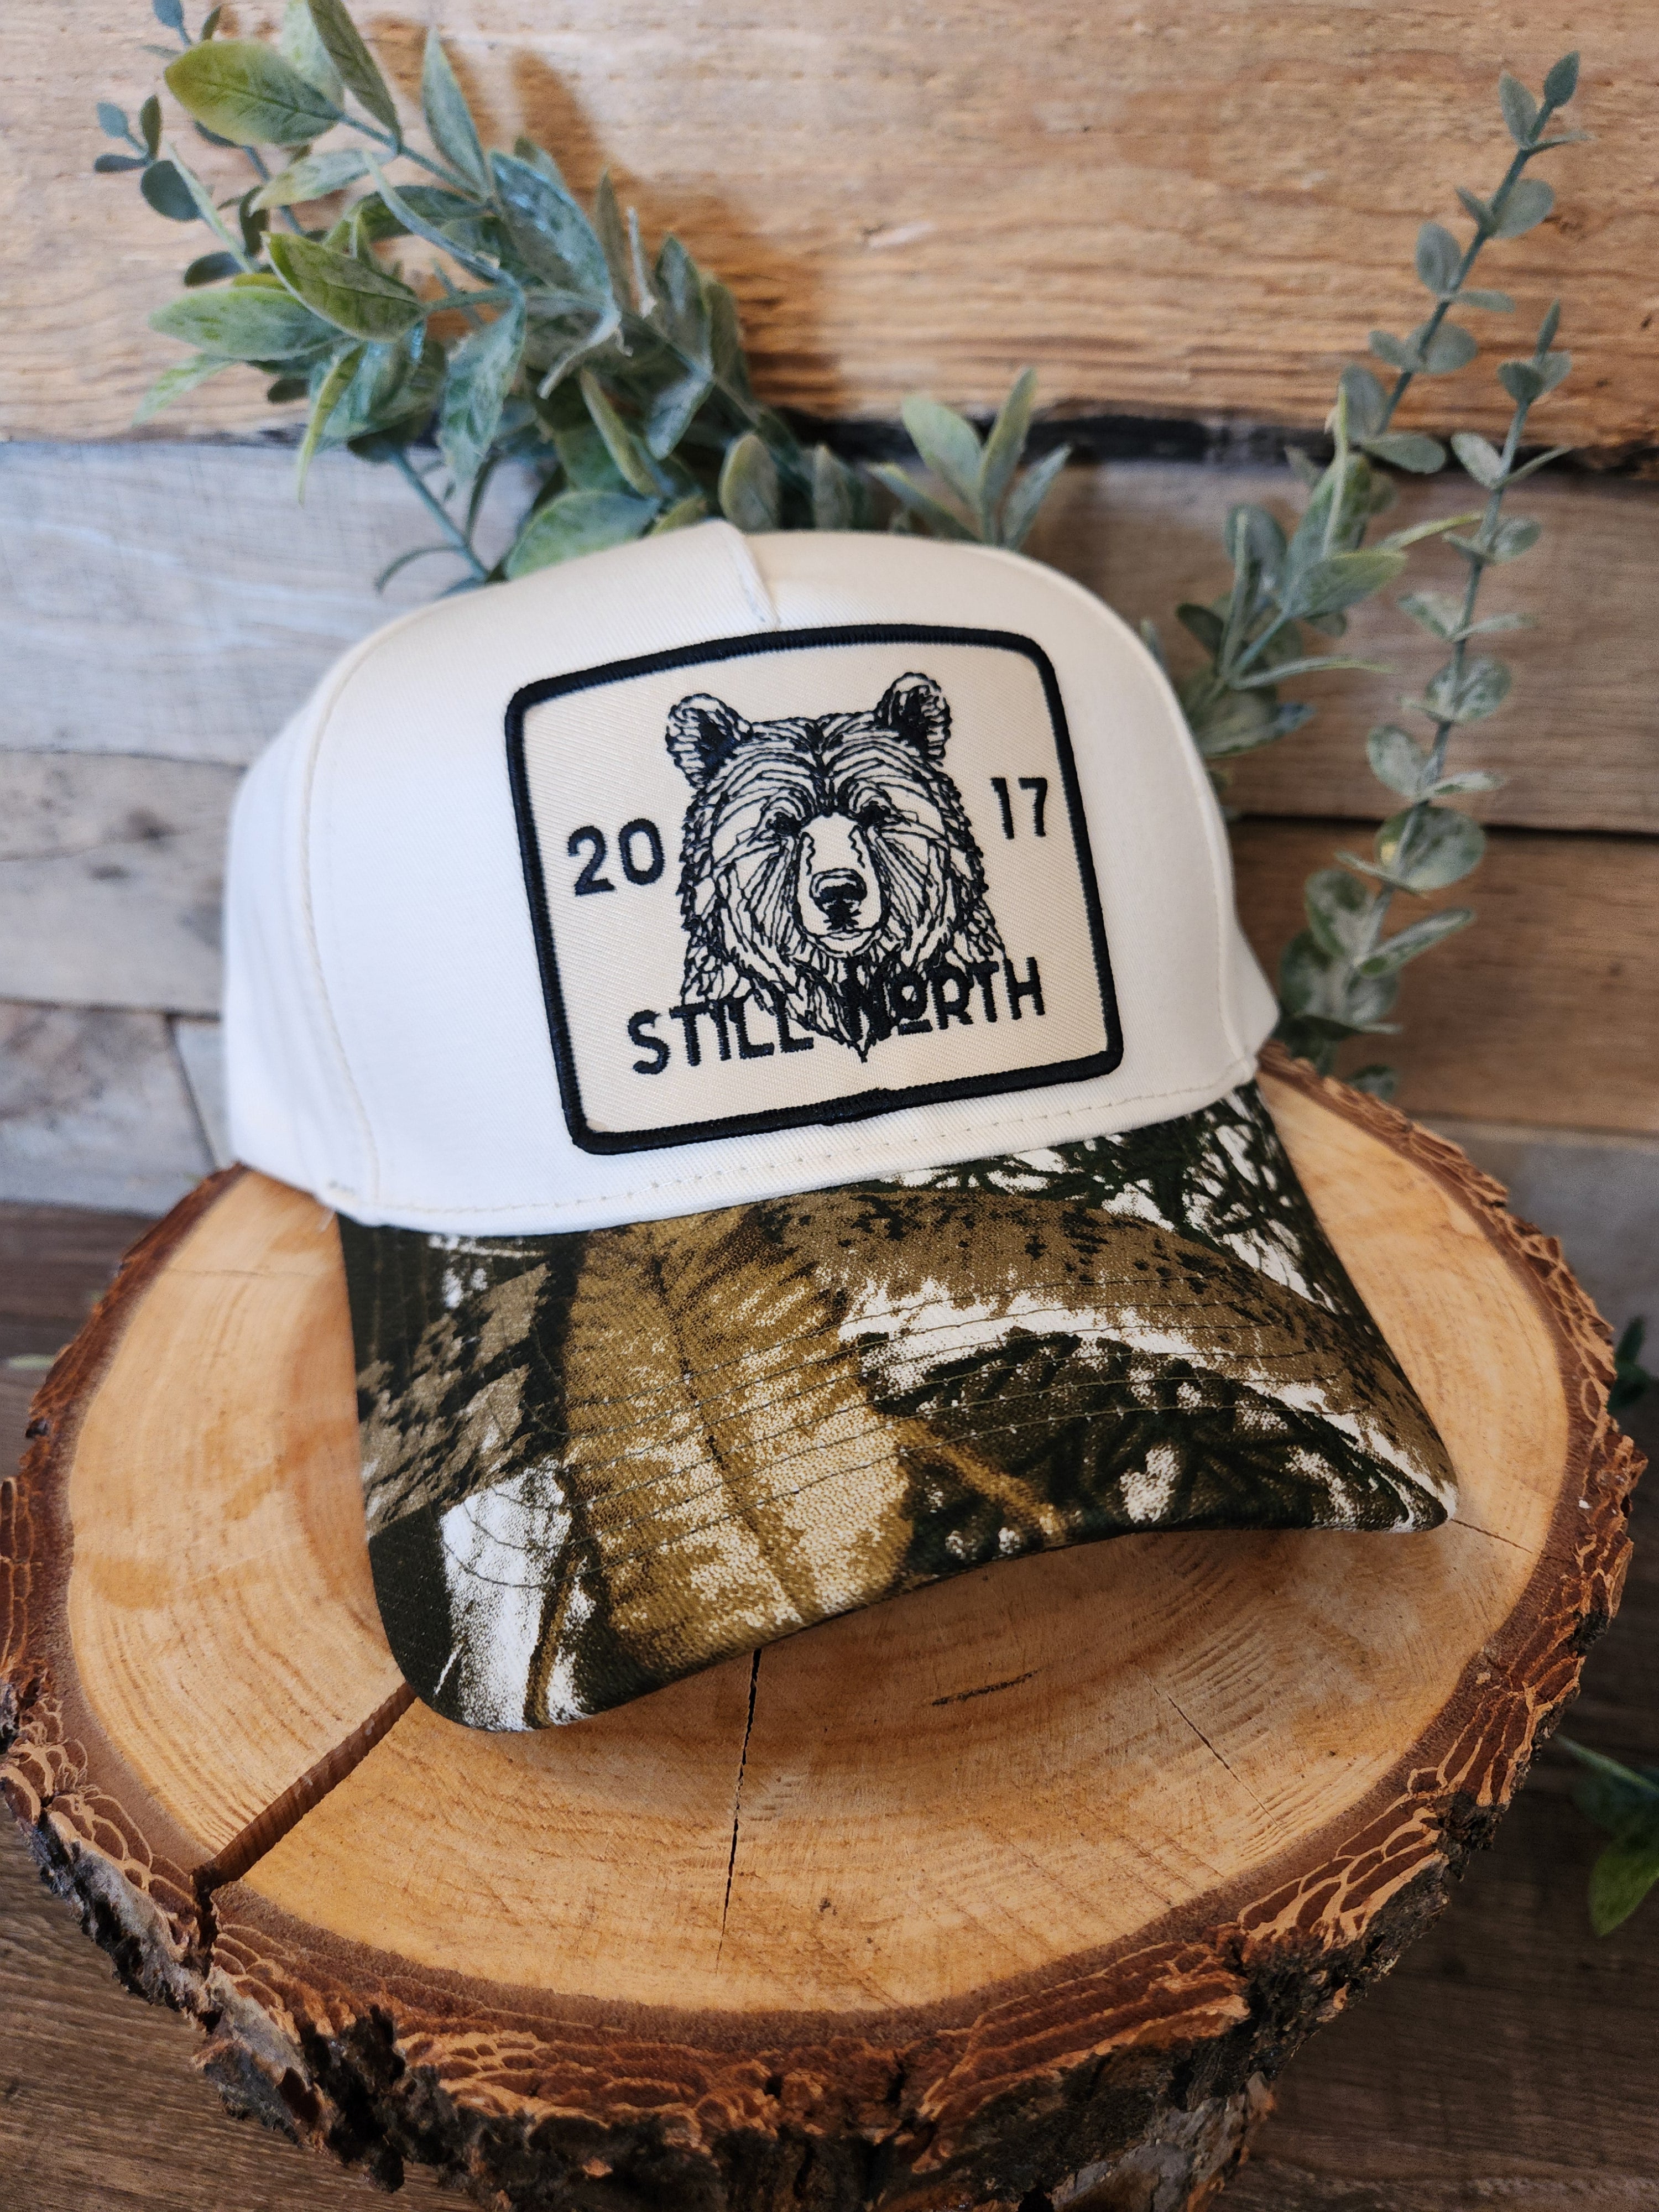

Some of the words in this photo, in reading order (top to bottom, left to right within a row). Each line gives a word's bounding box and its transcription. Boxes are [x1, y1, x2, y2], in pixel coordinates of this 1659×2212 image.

[567, 818, 665, 896] 20
[990, 777, 1047, 839] 17
[627, 990, 814, 1074] STILL
[844, 957, 1045, 1042] NORTH
